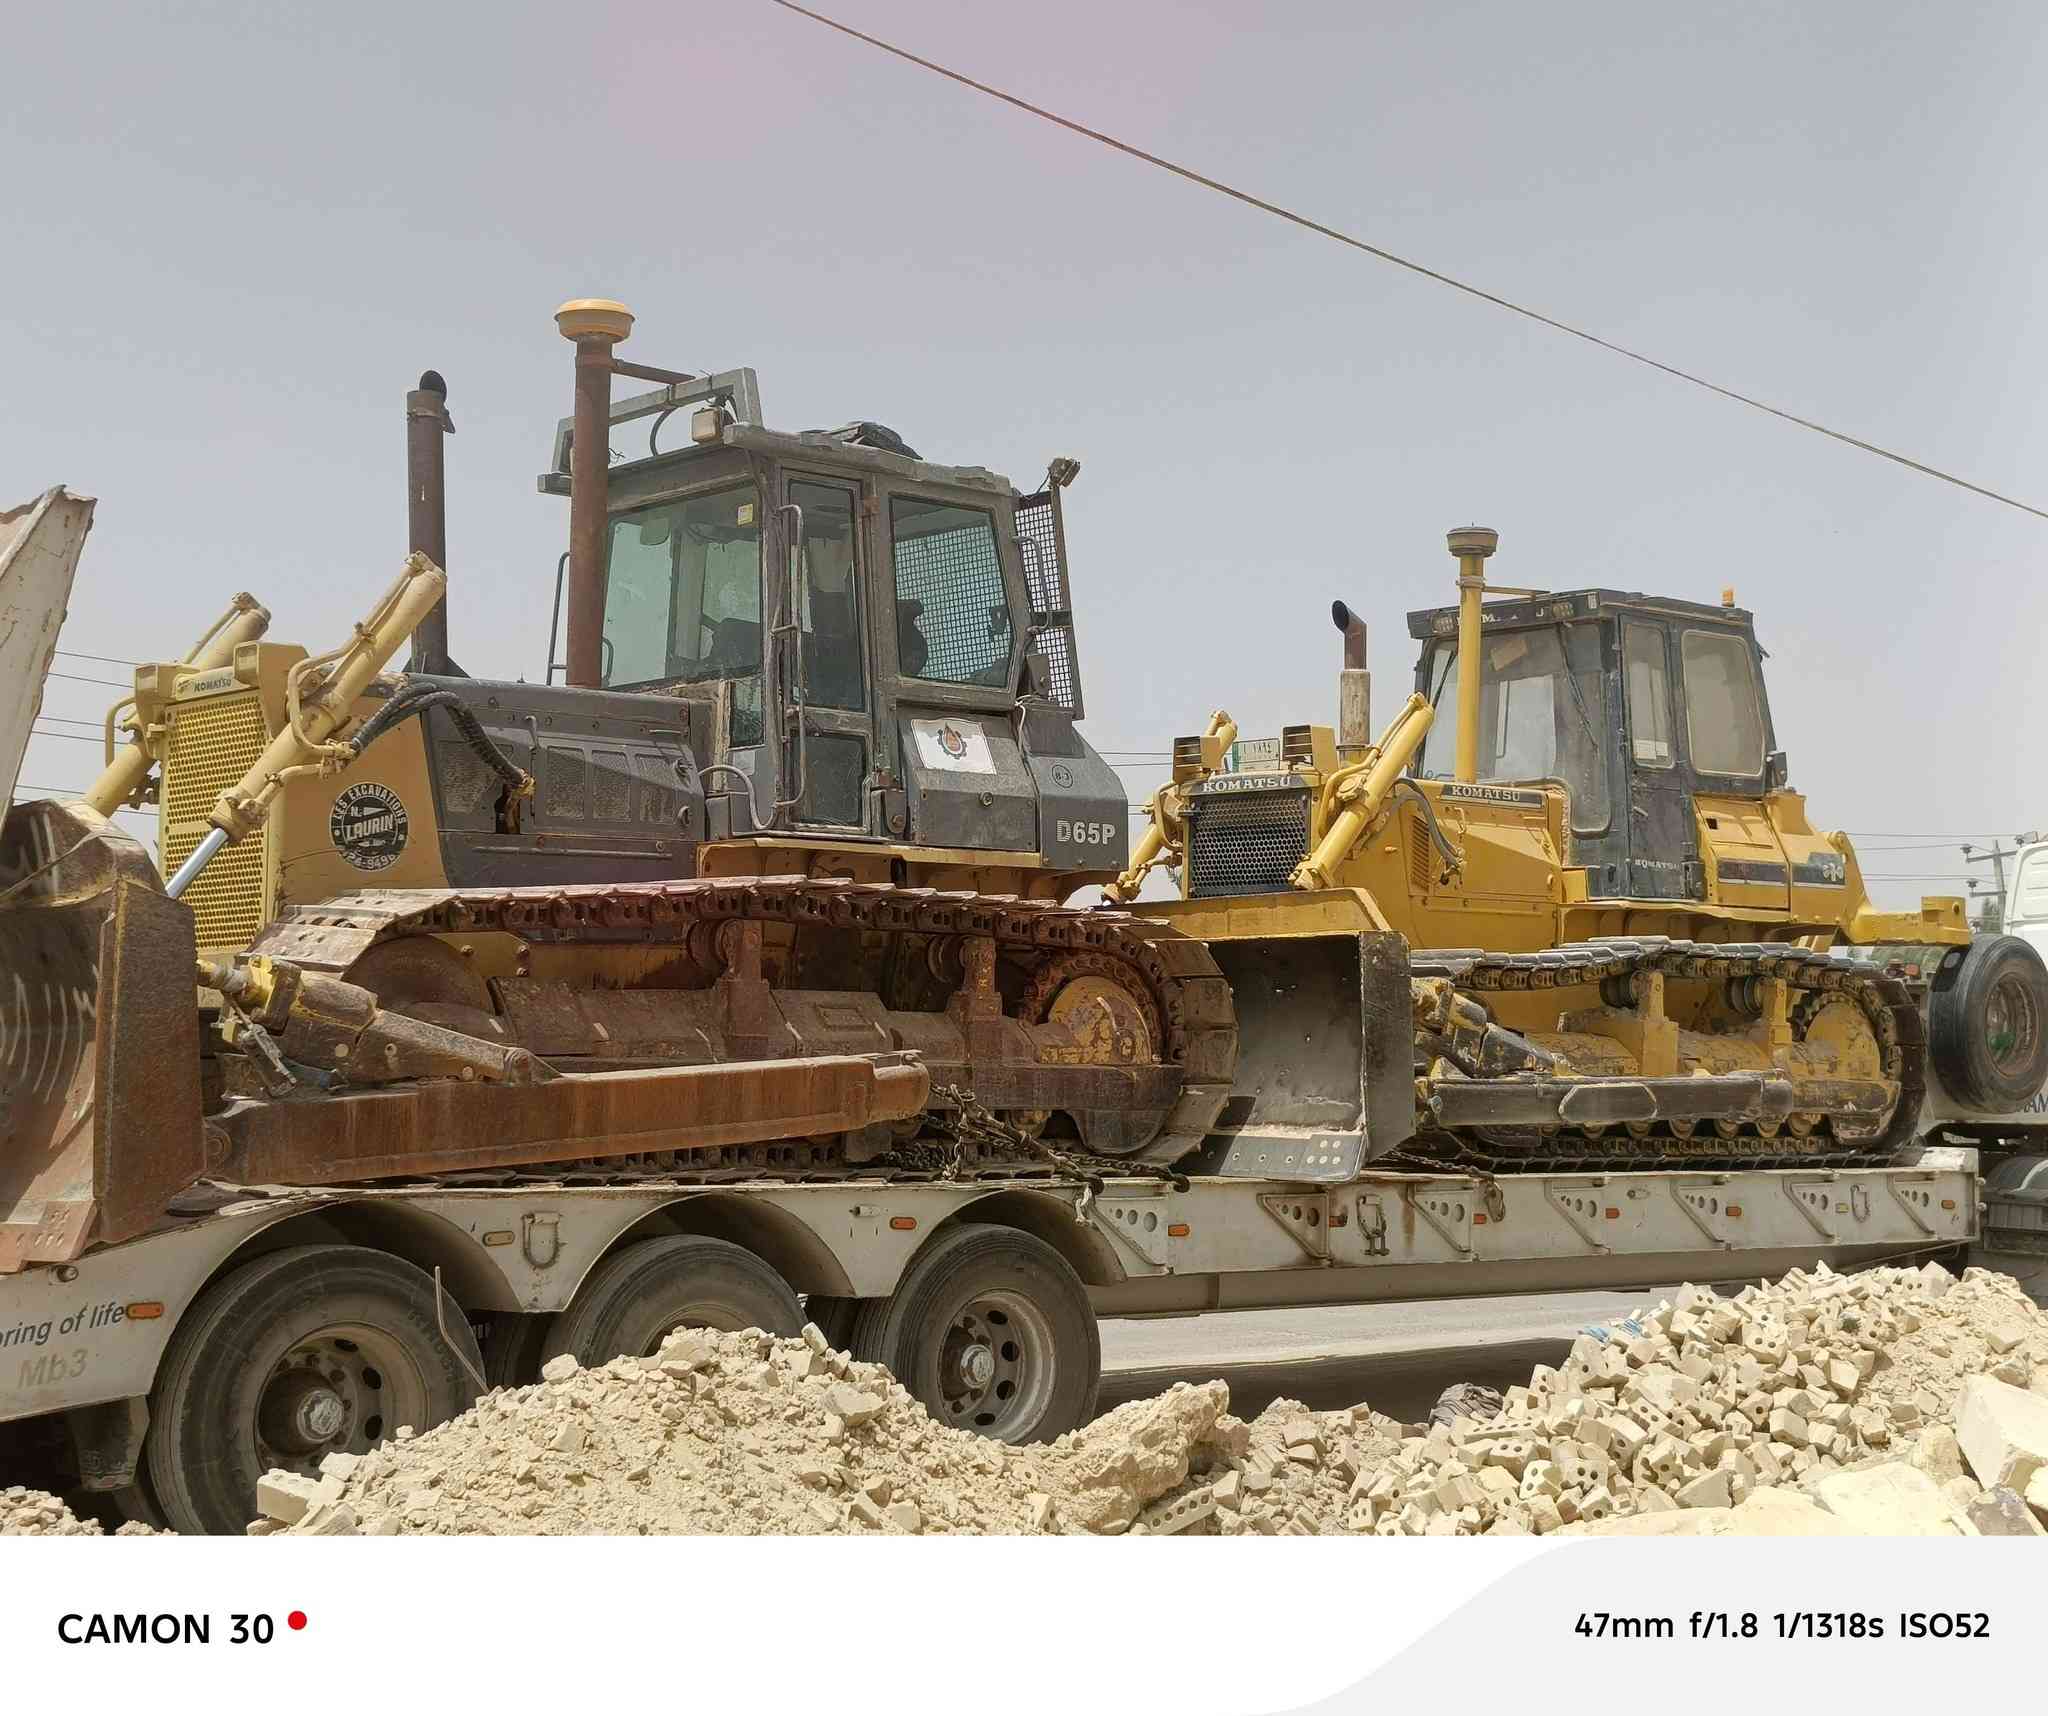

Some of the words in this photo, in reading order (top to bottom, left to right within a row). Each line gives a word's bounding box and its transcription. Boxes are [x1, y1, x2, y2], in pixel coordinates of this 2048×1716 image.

[194, 679, 232, 692] KOMATSU
[1202, 775, 1291, 793] KOMATSU
[1452, 785, 1520, 801] KOMATSU
[347, 784, 408, 824] EXCAVATIONS
[345, 814, 394, 840] LAURIN
[1055, 819, 1116, 845] D65P
[59, 1302, 88, 1335] of
[89, 1301, 126, 1329] life
